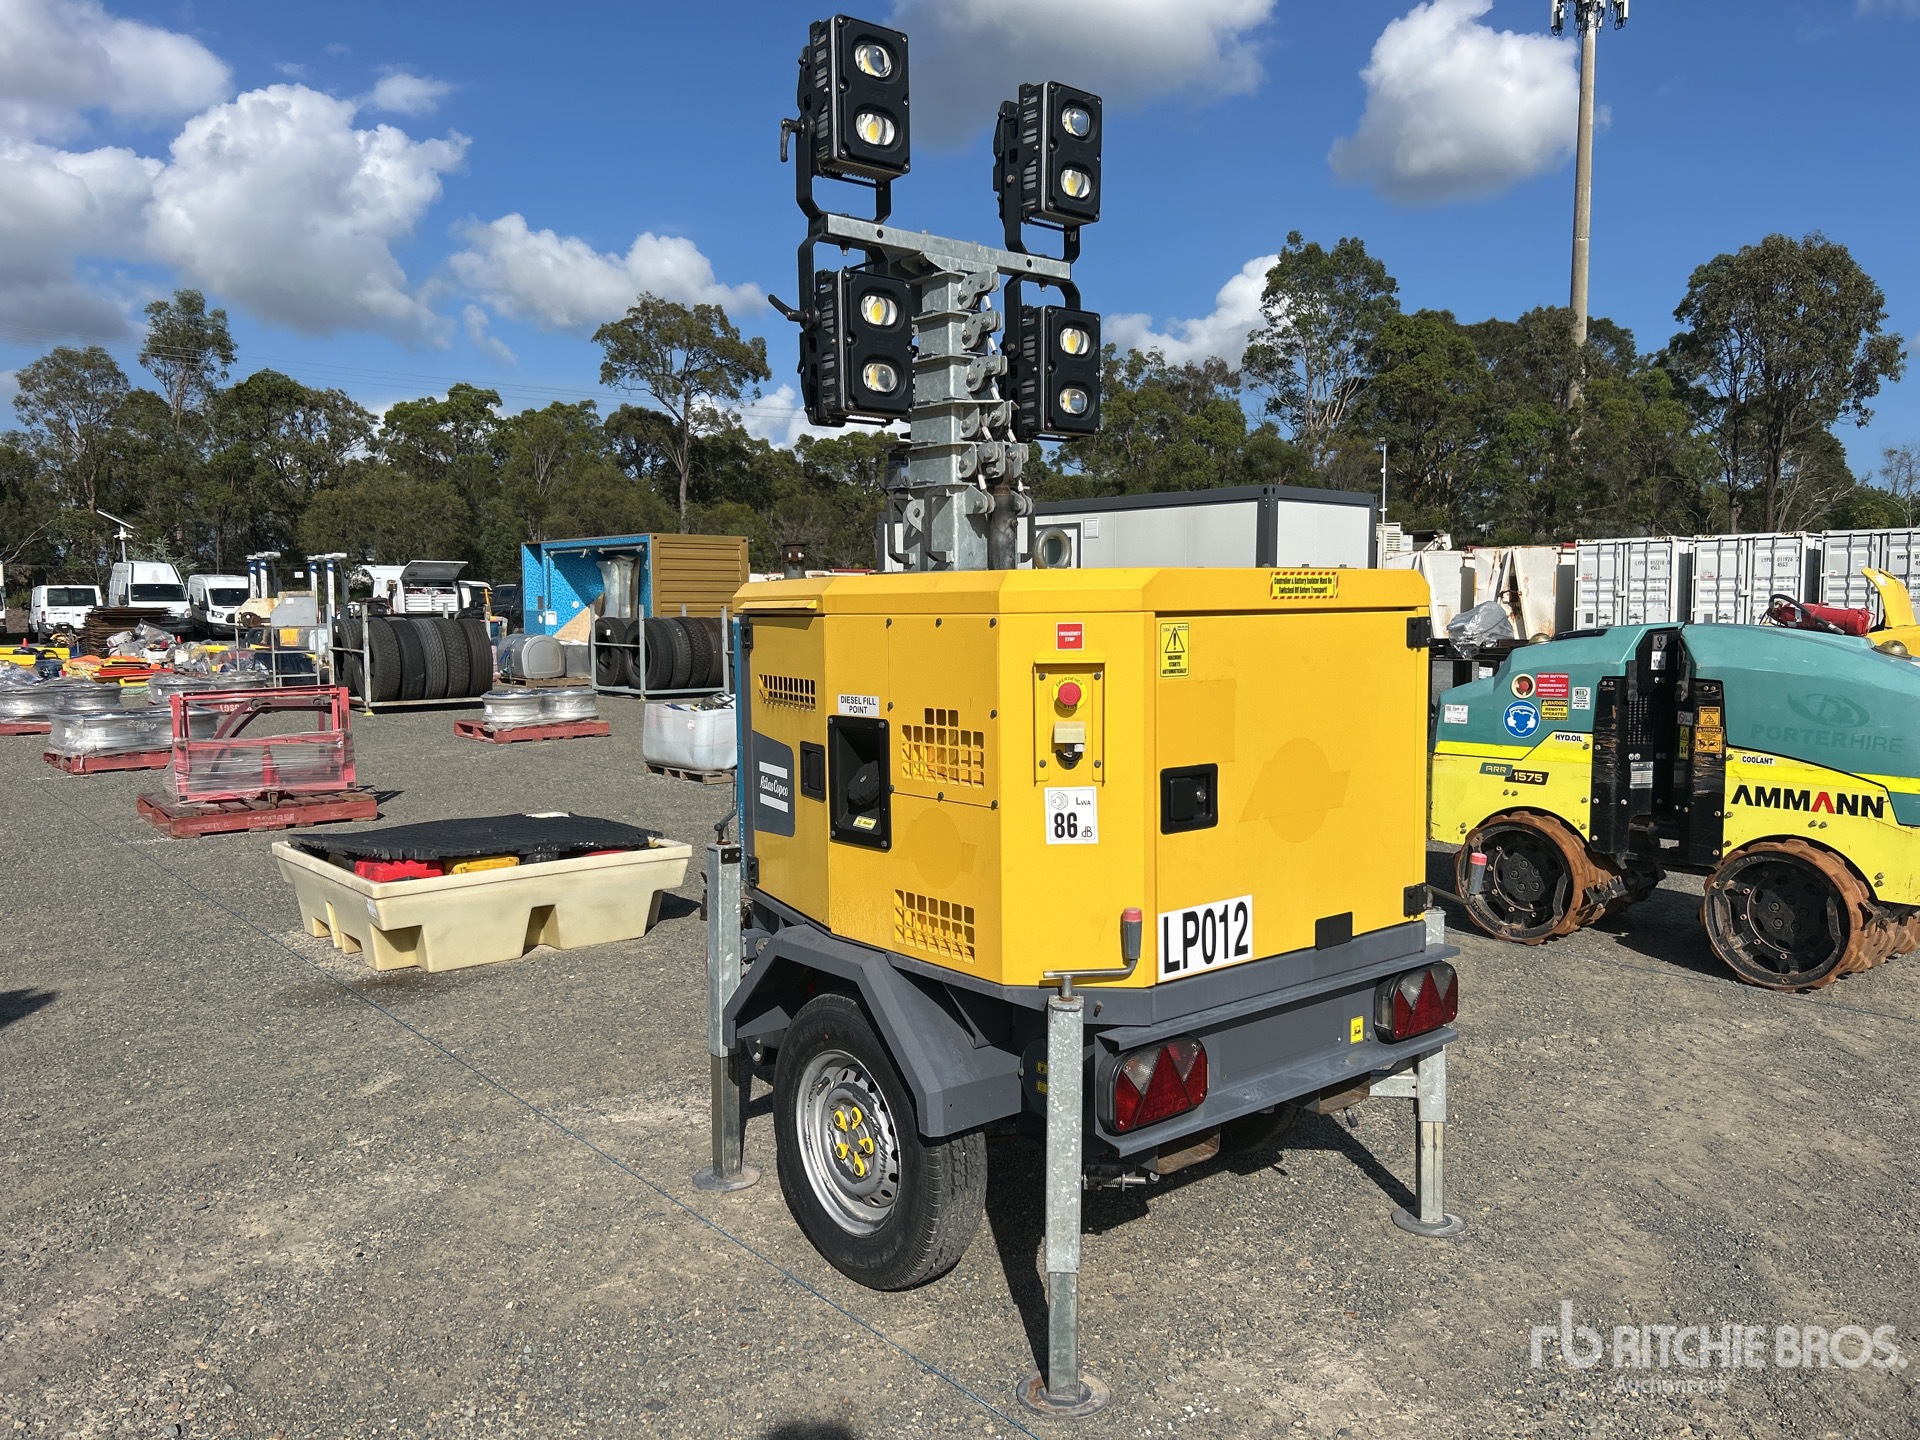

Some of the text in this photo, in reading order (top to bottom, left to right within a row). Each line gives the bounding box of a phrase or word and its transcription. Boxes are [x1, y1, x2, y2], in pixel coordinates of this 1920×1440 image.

[1055, 676, 1083, 687] EMERGENCY
[840, 695, 876, 705] DIESEL FILL
[849, 705, 868, 714] POINT
[1742, 755, 1774, 765] COOLANT
[1513, 771, 1543, 782] 1575
[760, 776, 789, 798] Atlas Copco
[1731, 784, 1884, 819] AMMANN
[1053, 812, 1078, 838] 86
[1081, 825, 1093, 838] dB
[1163, 901, 1248, 974] LP012
